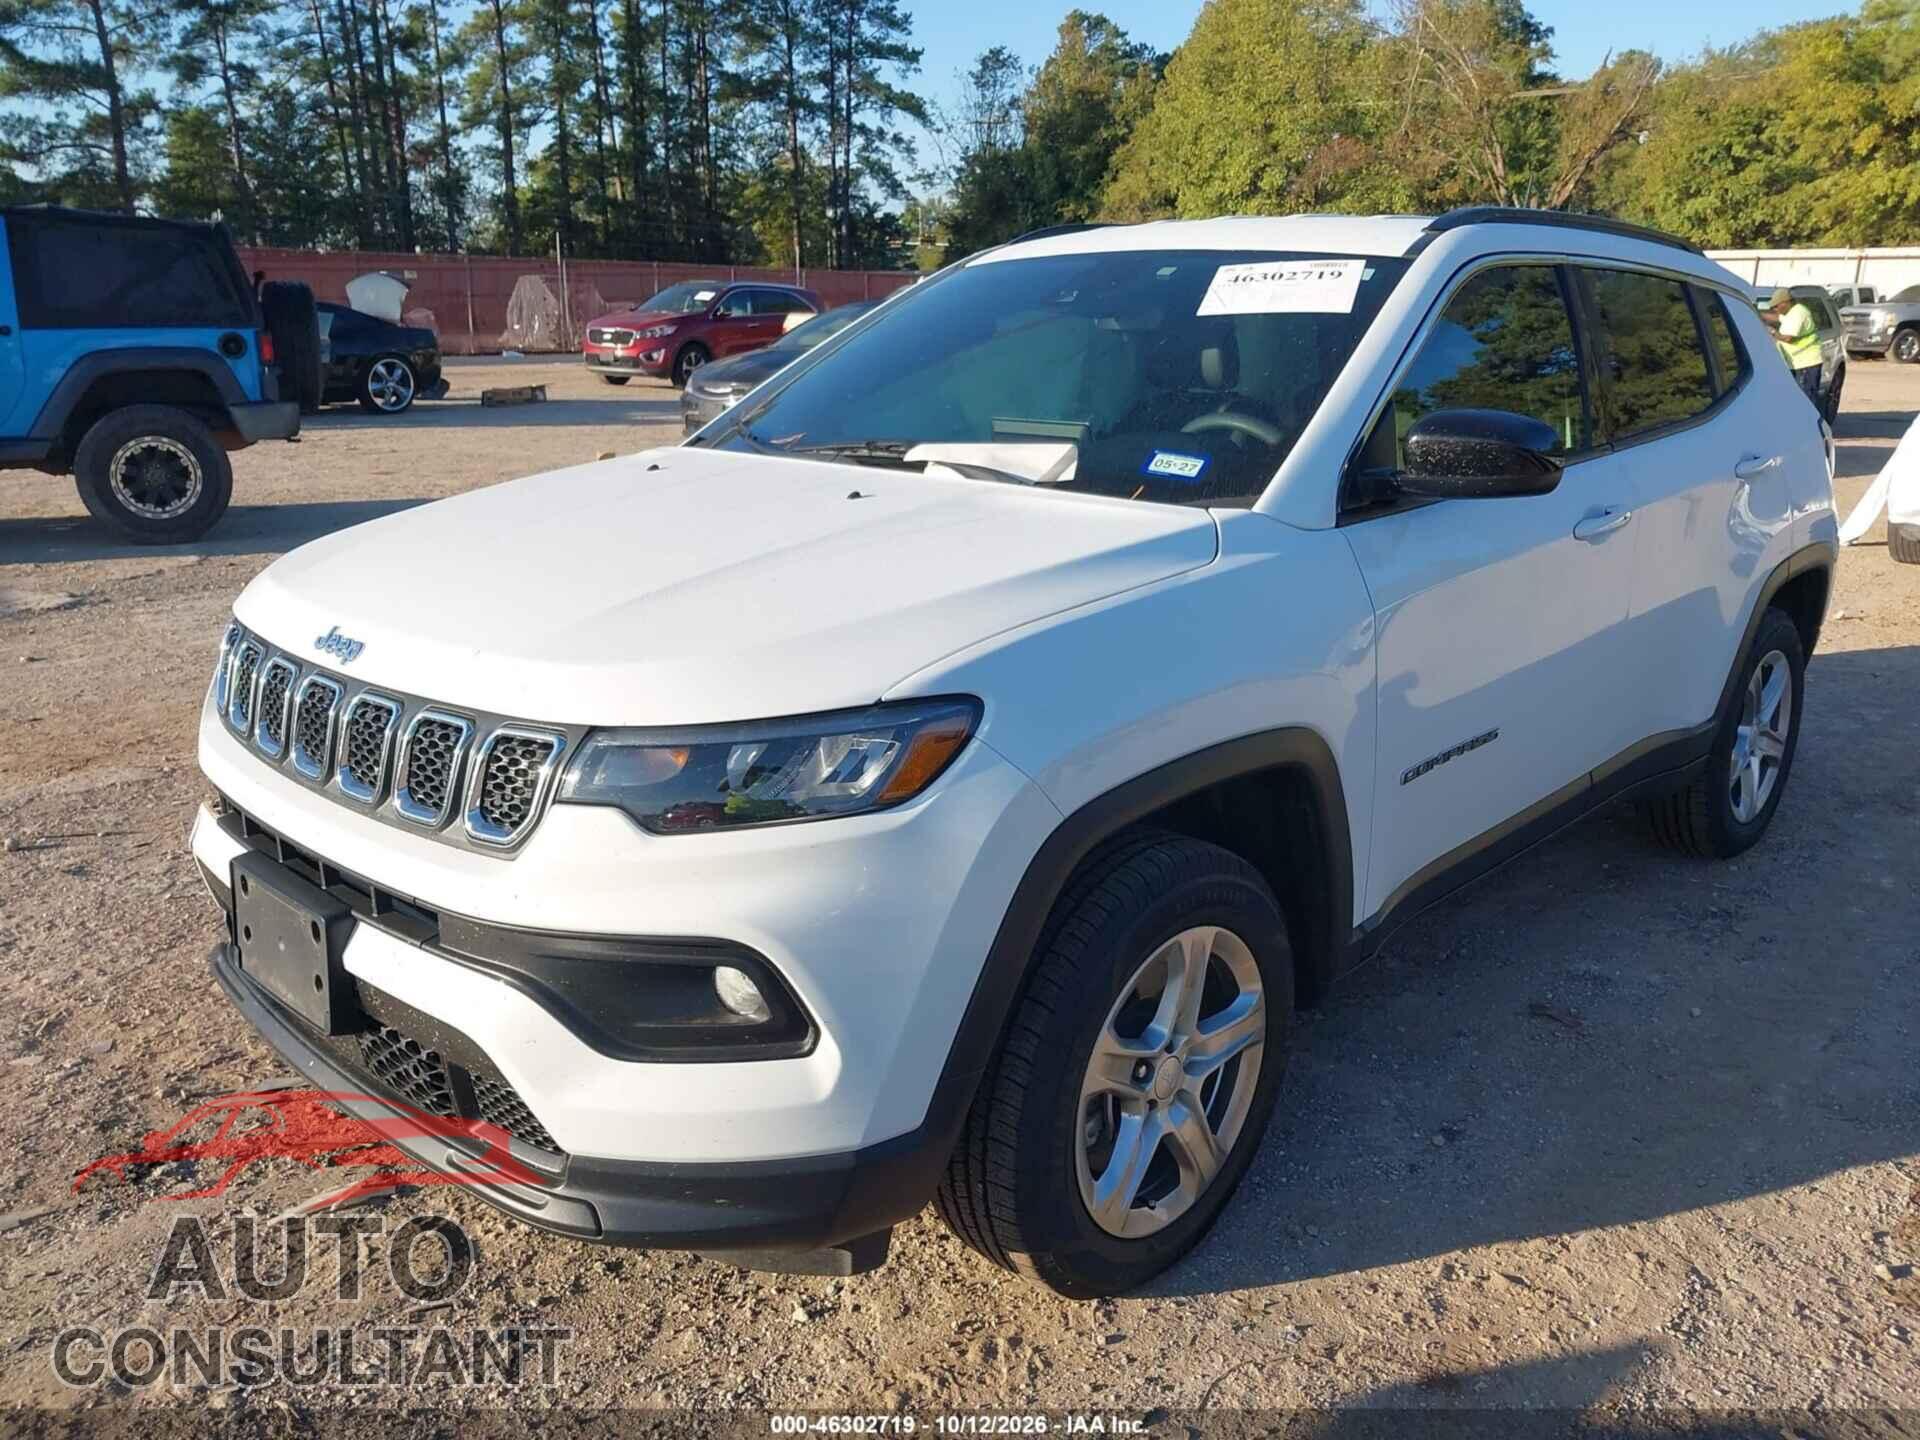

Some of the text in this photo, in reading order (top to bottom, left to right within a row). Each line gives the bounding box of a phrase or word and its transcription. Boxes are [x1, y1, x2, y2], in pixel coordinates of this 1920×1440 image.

[1227, 270, 1343, 284] 46302719
[314, 625, 366, 666] Jeep
[1400, 728, 1500, 786] COMPASS
